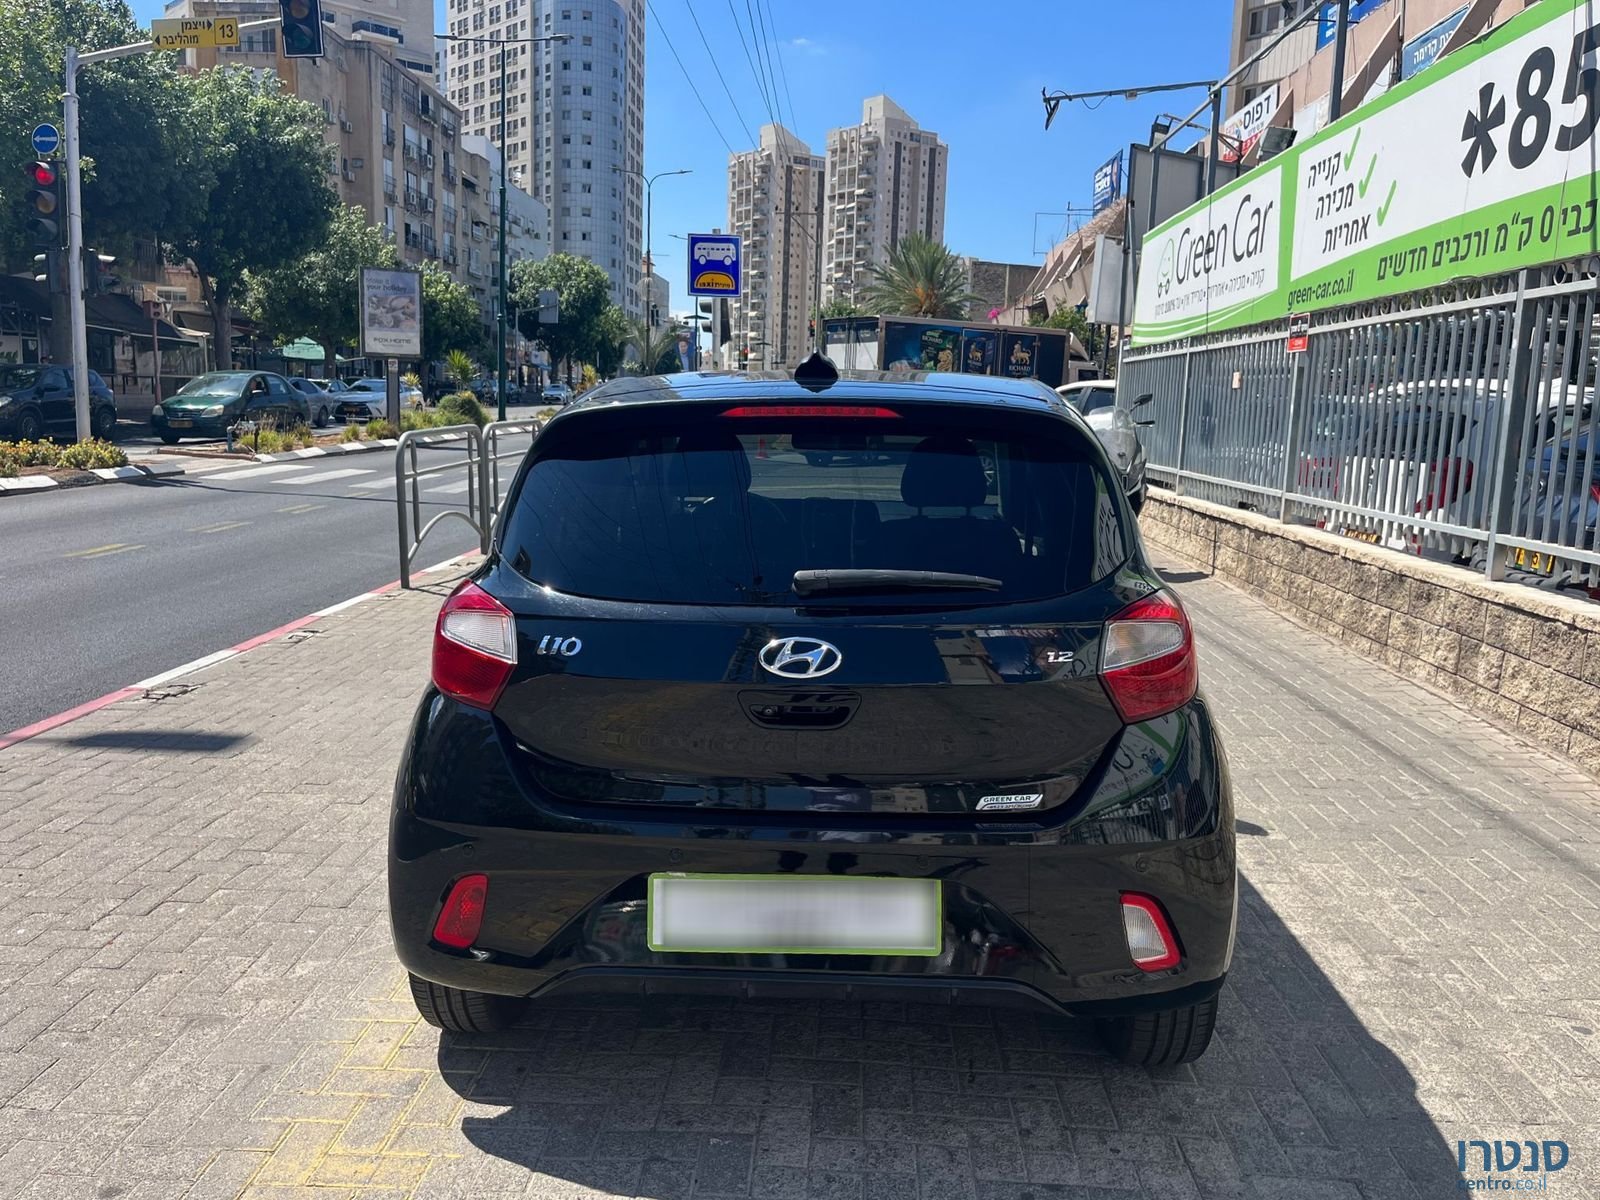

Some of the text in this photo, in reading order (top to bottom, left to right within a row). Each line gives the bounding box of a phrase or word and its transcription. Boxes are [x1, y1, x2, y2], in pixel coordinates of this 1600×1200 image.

[163, 32, 199, 45] מוהליבר
[181, 20, 206, 33] ויצמן
[219, 24, 234, 39] 13
[1414, 38, 1438, 64] קדימה
[1243, 95, 1271, 130] דפוס
[1308, 151, 1341, 189] קנייה
[1315, 182, 1354, 220] מכירה
[1176, 194, 1274, 285] Green Car
[1322, 214, 1371, 254] אחריות
[1539, 205, 1554, 243] 0
[1377, 246, 1428, 281] חדשים
[1431, 228, 1490, 268] ורכבים
[1287, 269, 1354, 311] green-car.co.il
[537, 635, 582, 657] i10
